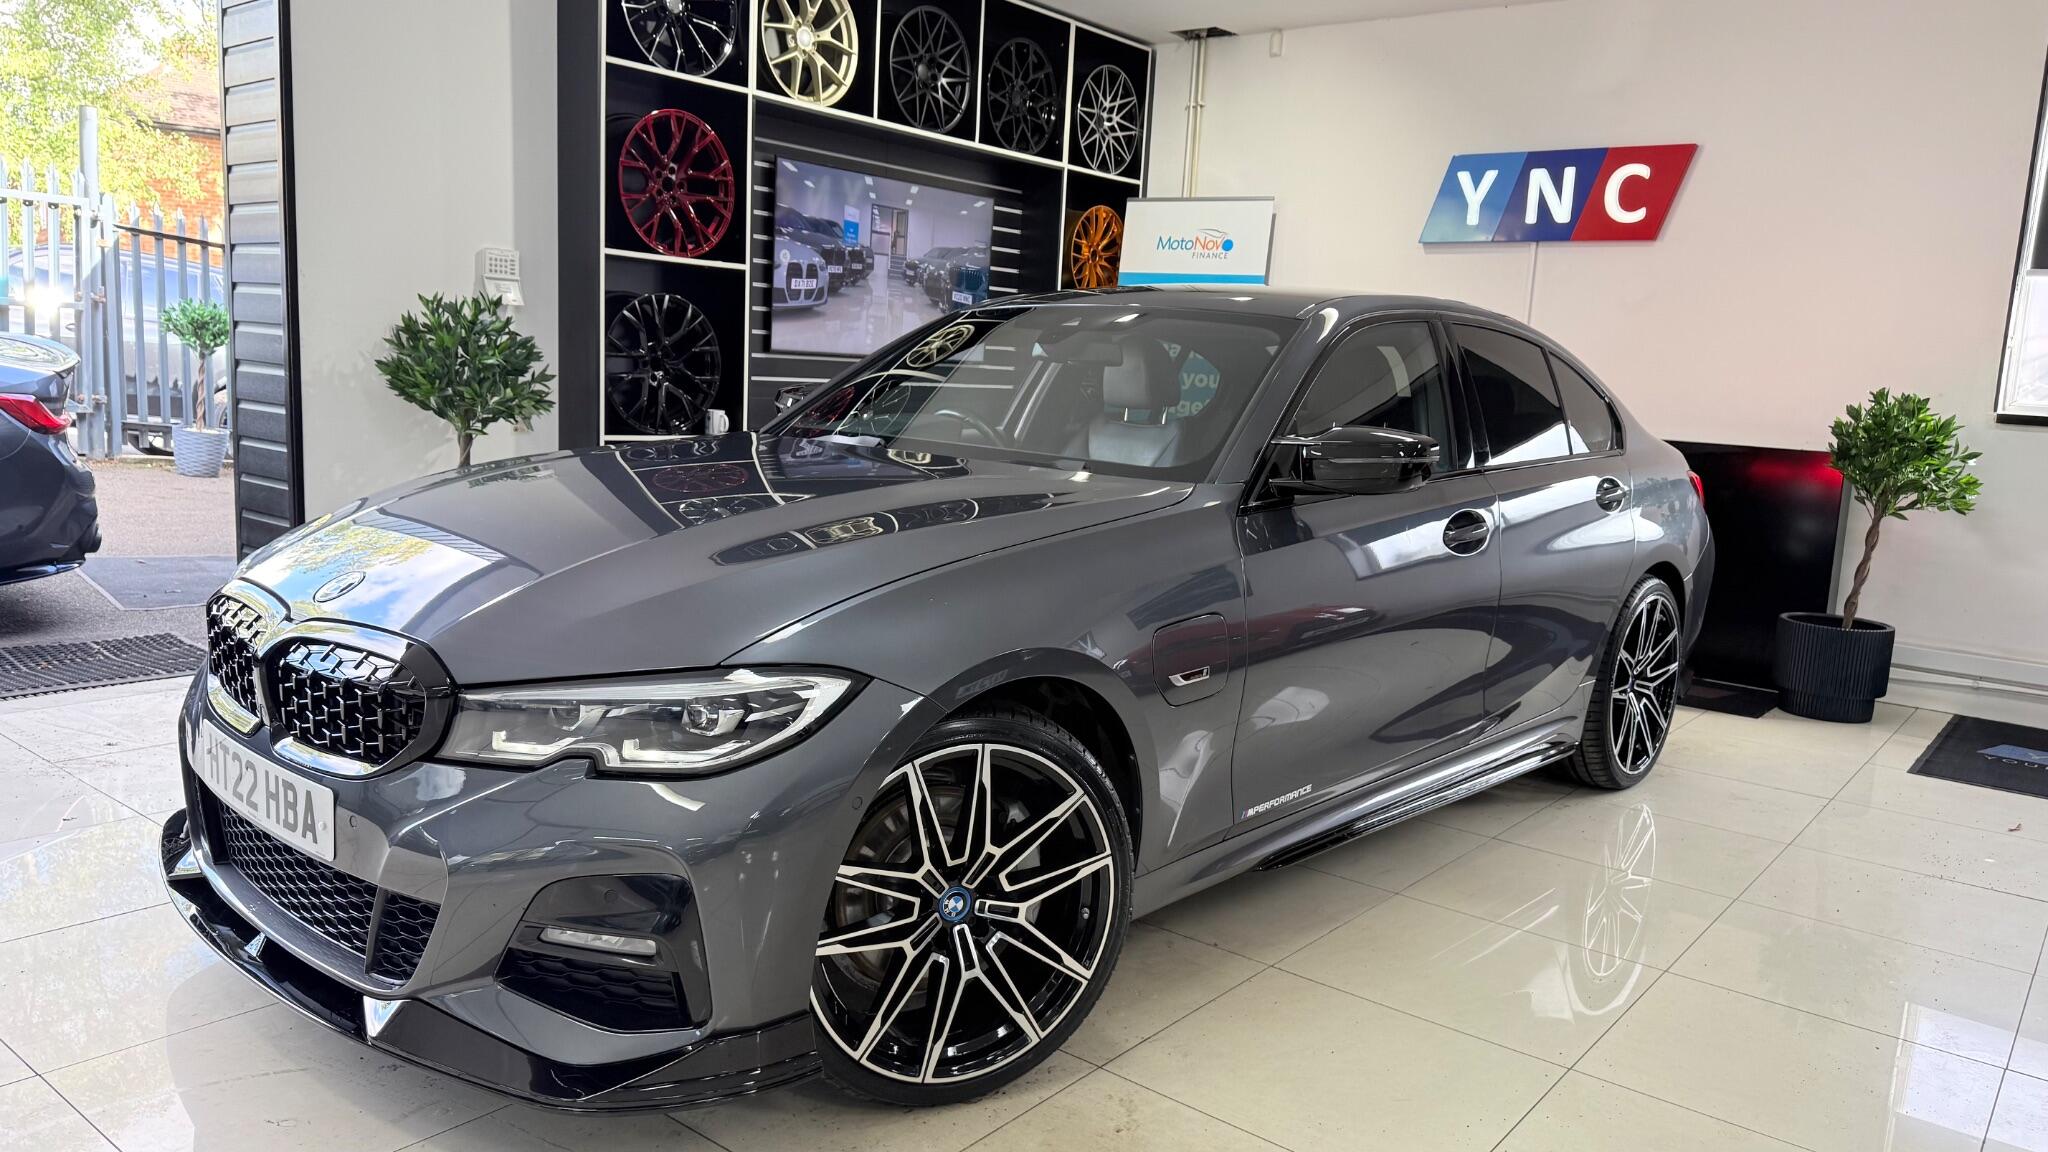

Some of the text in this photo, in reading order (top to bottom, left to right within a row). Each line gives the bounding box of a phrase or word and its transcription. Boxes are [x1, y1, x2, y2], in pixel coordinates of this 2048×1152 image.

[1456, 163, 1650, 226] YNC
[1191, 252, 1229, 260] FINANCE
[1983, 754, 2048, 770] YOU
[264, 769, 318, 845] HBA
